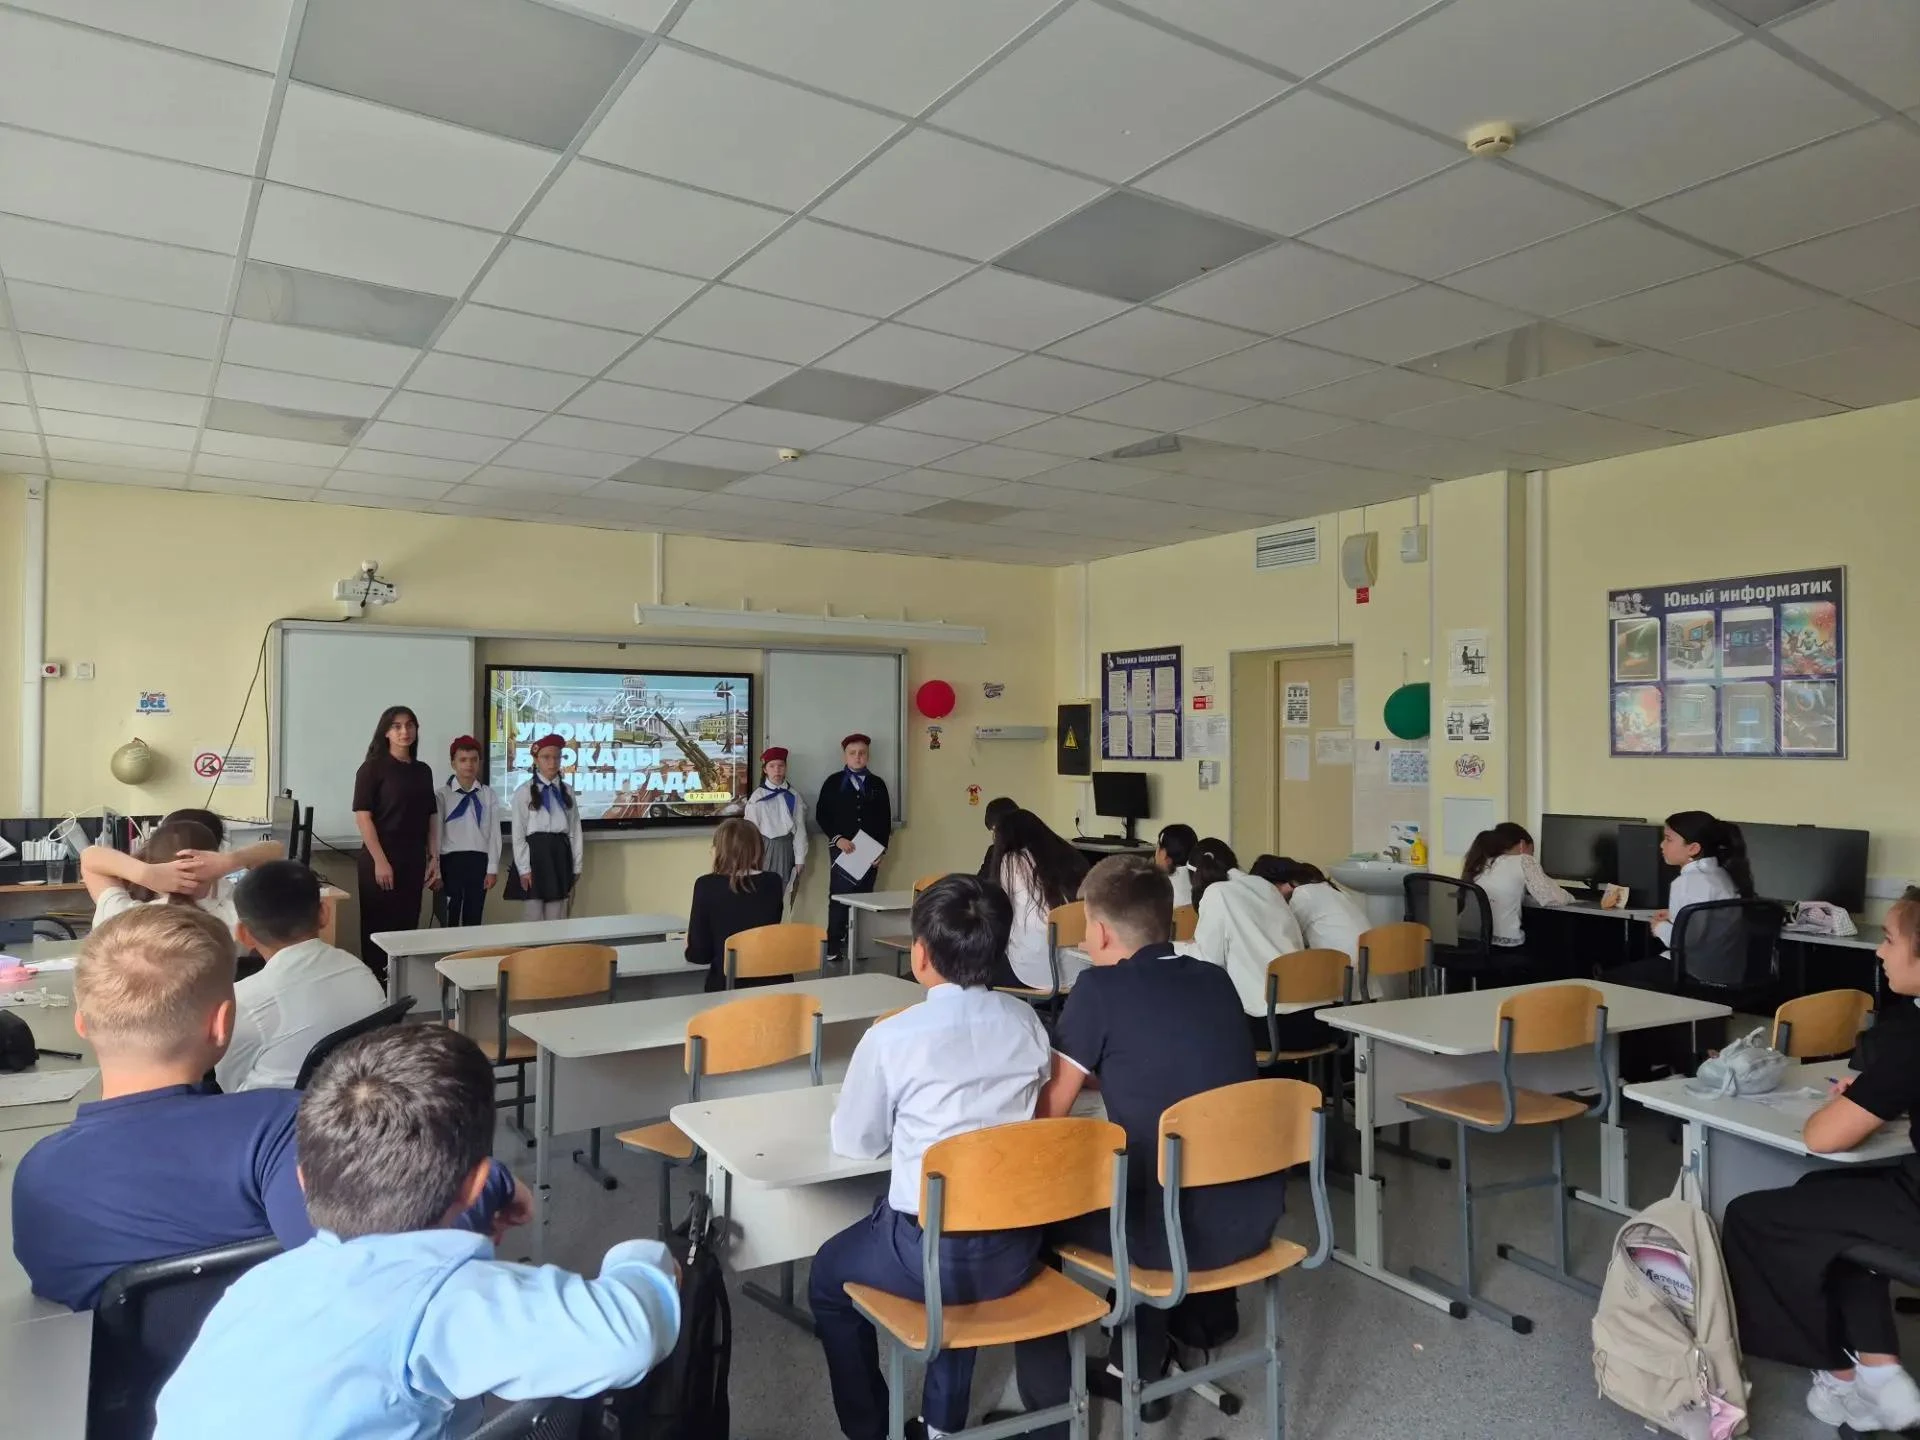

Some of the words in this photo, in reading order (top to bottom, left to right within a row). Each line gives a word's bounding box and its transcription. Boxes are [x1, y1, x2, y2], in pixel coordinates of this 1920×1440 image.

[1664, 589, 1715, 607] Юный
[1719, 580, 1832, 603] информатик
[516, 722, 614, 741] УРОКИ
[513, 747, 661, 769] БОКАДЫ
